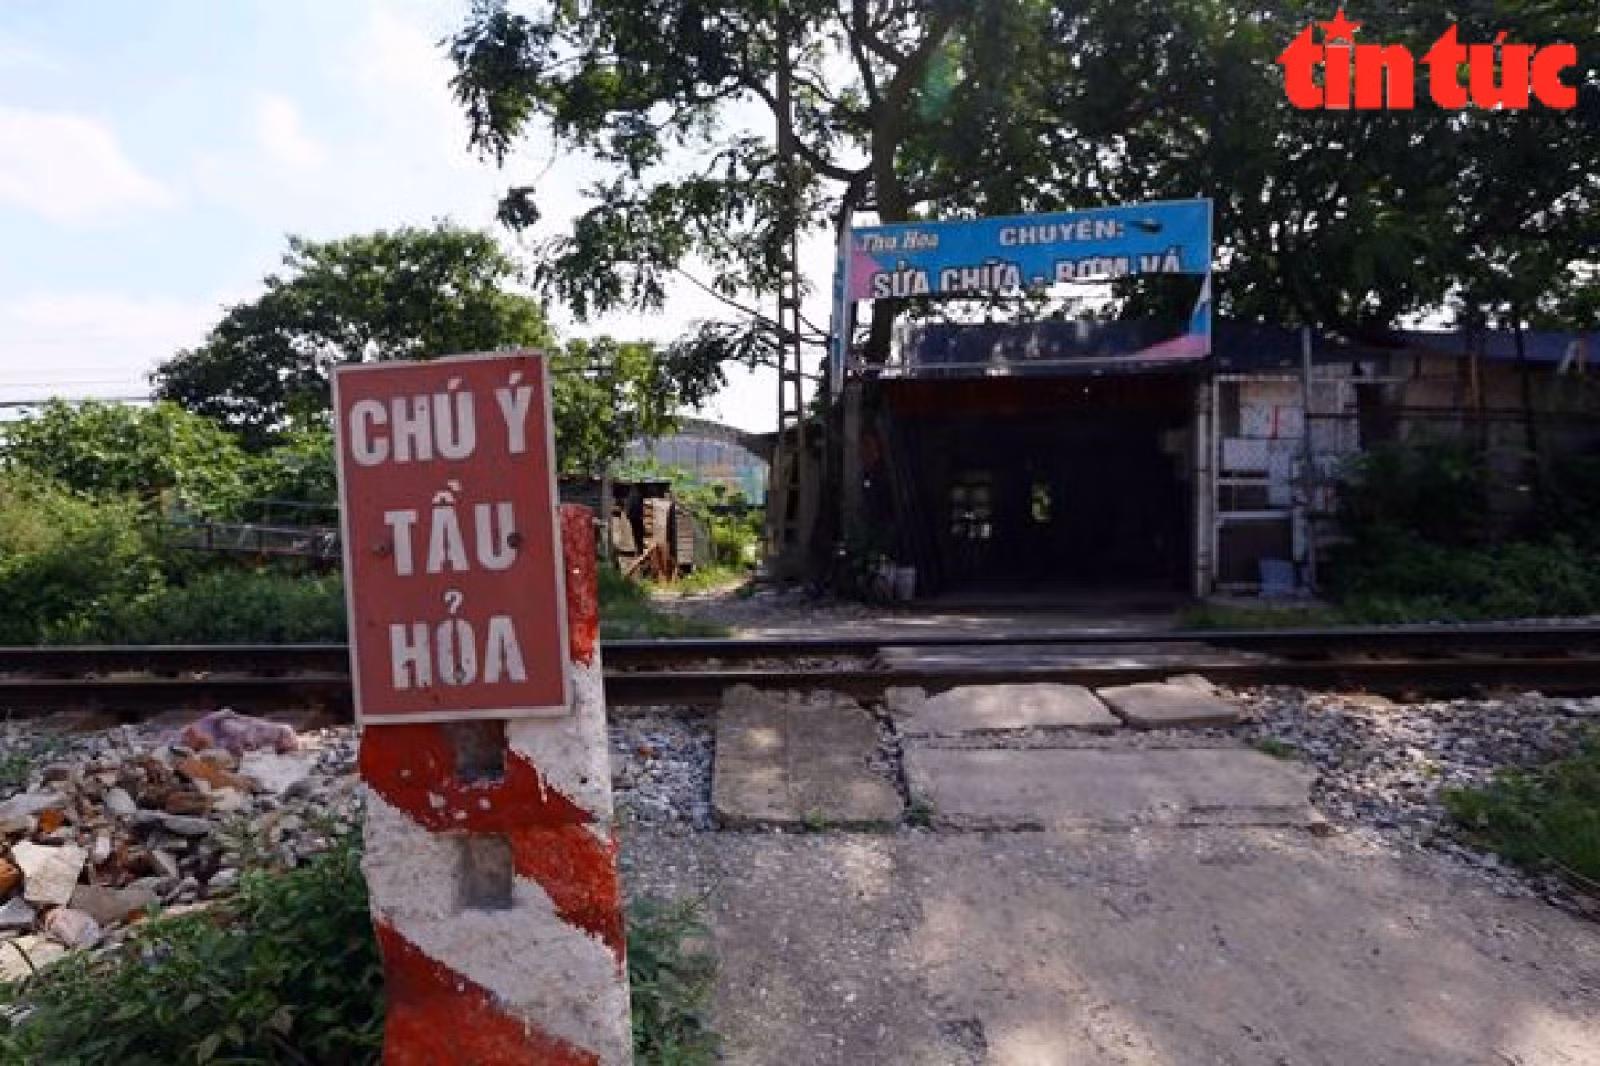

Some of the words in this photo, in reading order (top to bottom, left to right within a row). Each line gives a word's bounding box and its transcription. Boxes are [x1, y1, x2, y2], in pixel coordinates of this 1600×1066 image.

[874, 260, 929, 298] SỬA
[940, 258, 1020, 295] CHỮA
[349, 377, 477, 466] CHÚ
[495, 372, 532, 453] Ý
[383, 478, 520, 576] TẦU
[388, 590, 528, 690] HỎA
